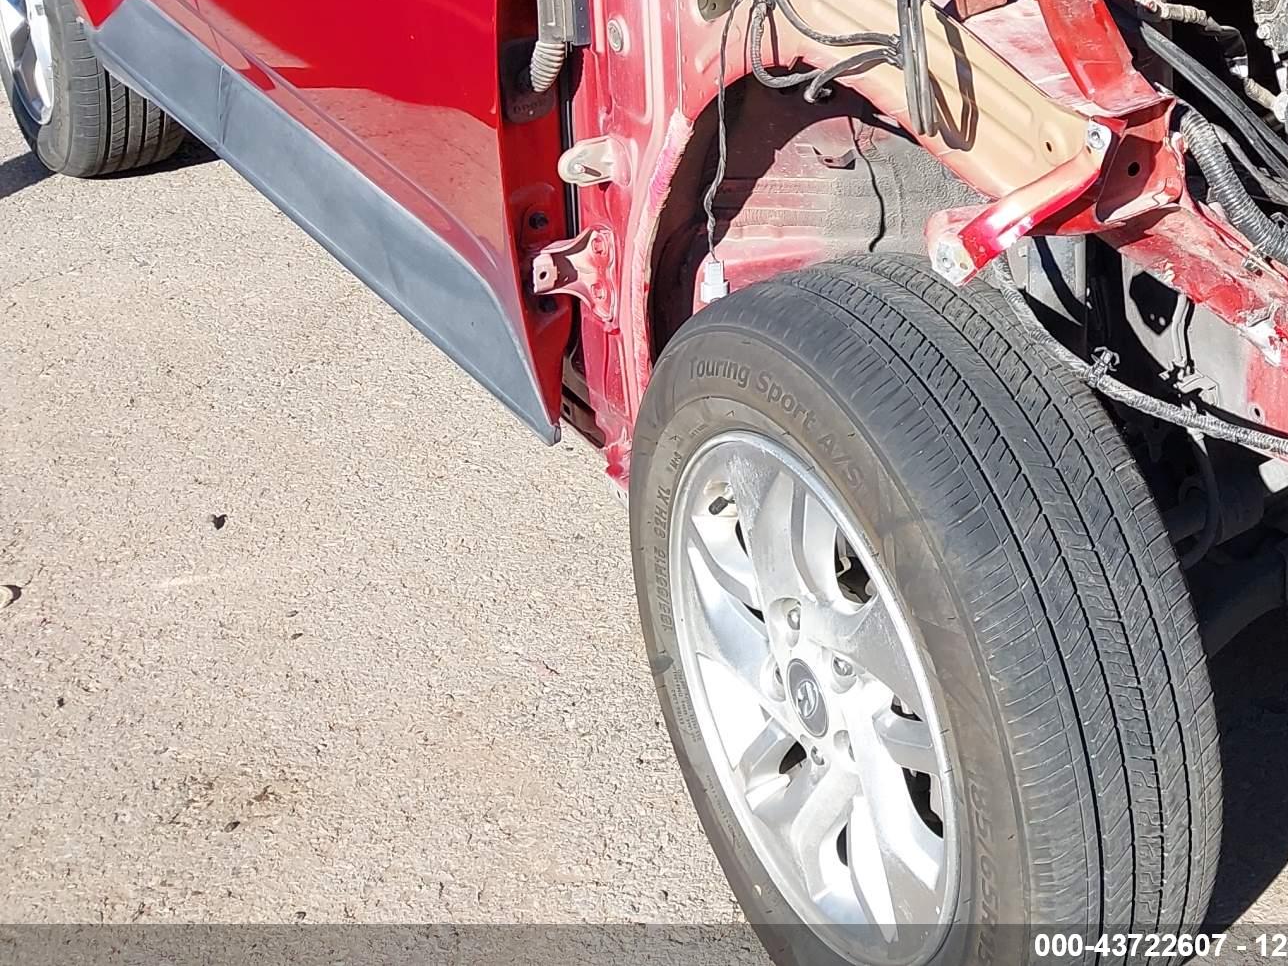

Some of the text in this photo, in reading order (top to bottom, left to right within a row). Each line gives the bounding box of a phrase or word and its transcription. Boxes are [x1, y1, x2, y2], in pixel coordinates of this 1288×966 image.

[689, 358, 865, 488] Touring Sport A/S
